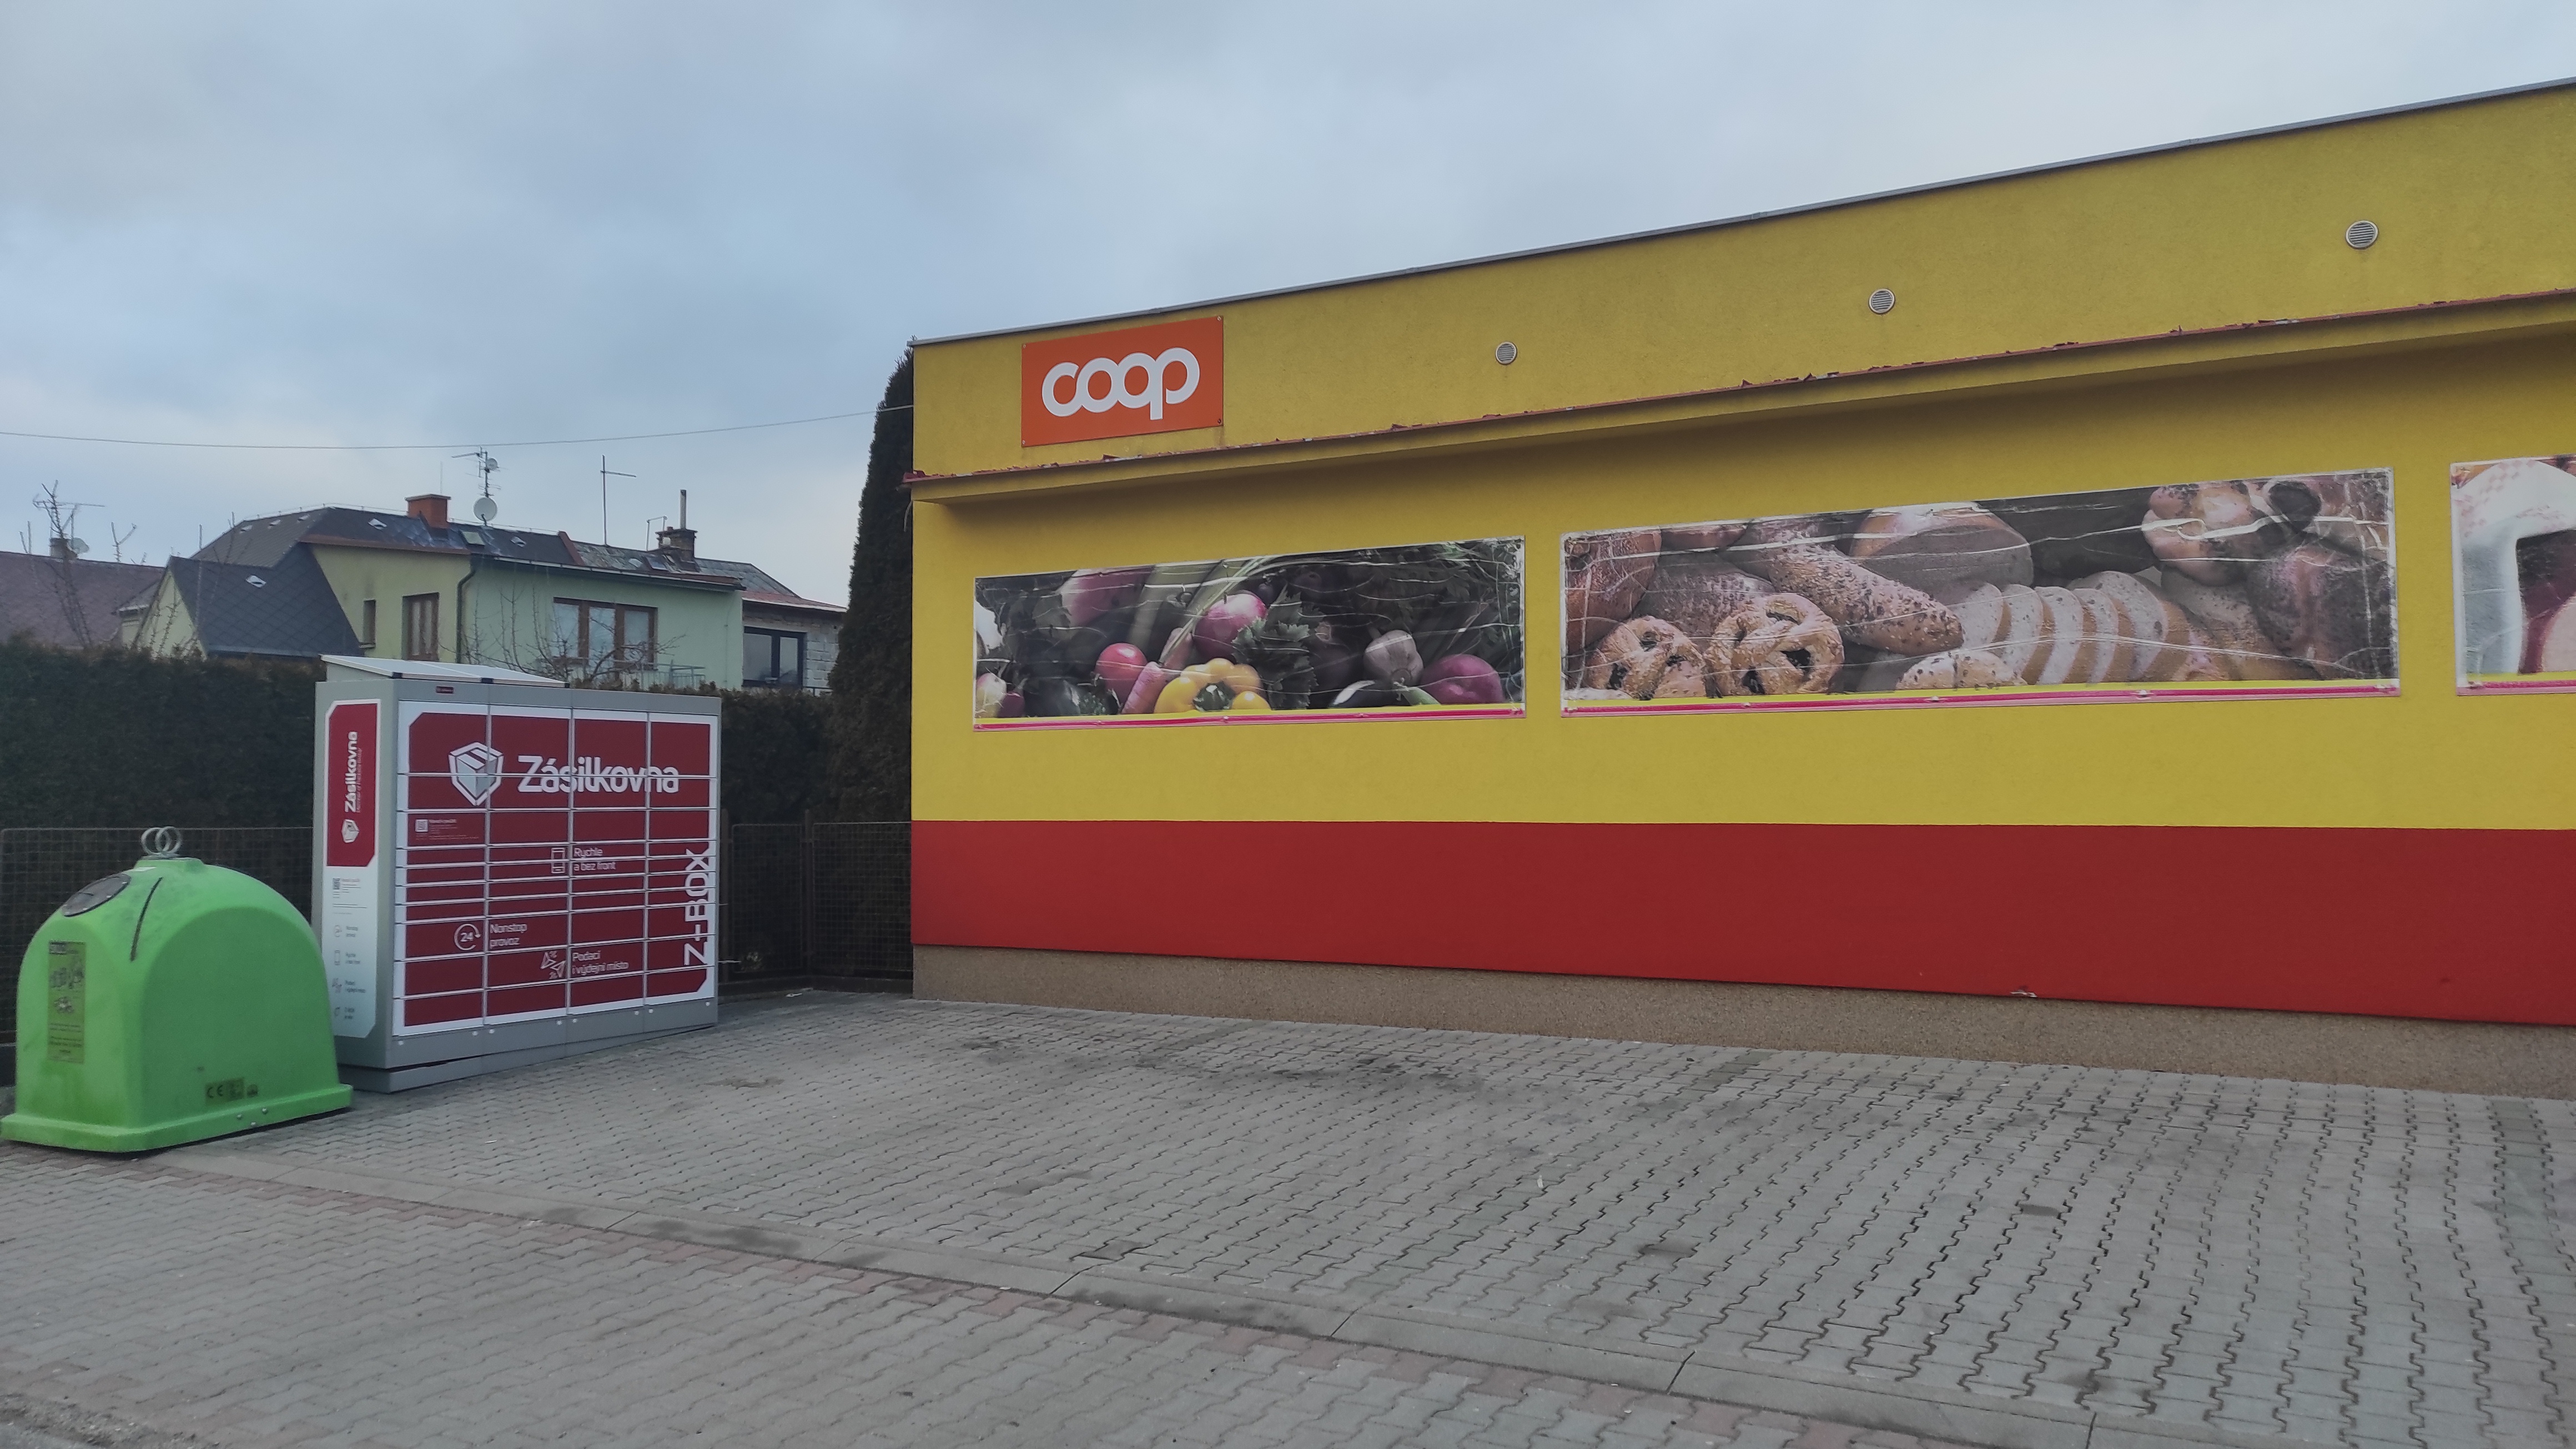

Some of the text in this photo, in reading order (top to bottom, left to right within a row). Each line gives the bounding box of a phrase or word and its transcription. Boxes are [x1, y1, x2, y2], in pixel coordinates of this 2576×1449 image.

[1042, 347, 1200, 420] coop
[345, 731, 358, 813] Zásilkovna
[517, 755, 679, 793] Zásilkovna
[490, 923, 527, 933] Nonstop
[683, 848, 709, 965] Z-BOX
[460, 932, 474, 942] 24
